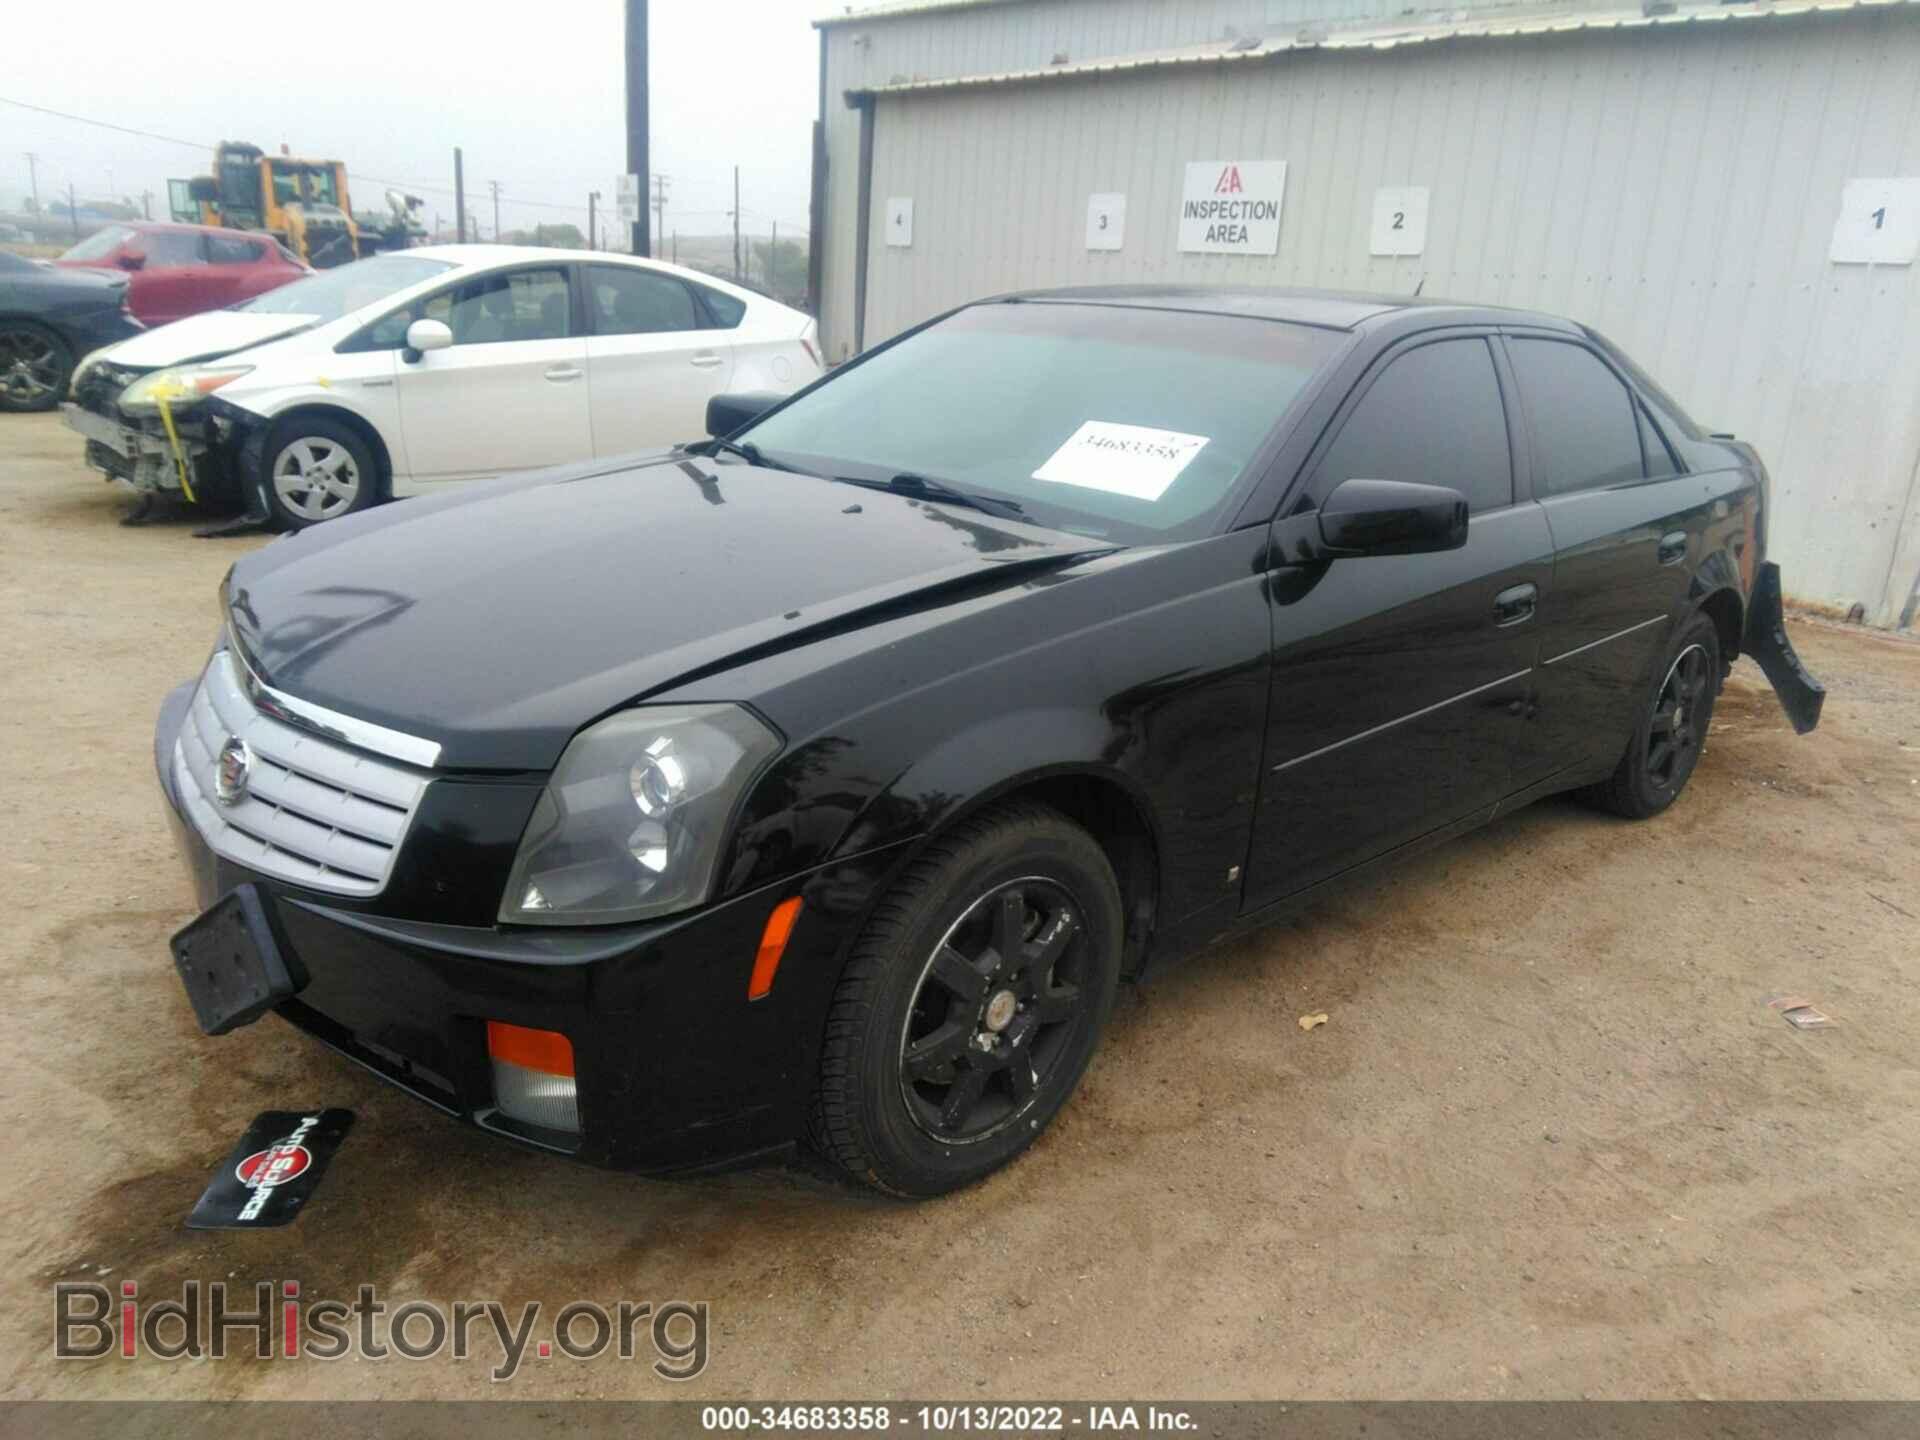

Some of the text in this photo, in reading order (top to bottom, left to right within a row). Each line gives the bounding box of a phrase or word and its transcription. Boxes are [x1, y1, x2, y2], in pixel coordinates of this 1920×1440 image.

[895, 212, 903, 226] 4
[1184, 200, 1278, 220] INSPECTION
[1871, 207, 1886, 229] 1
[1099, 214, 1108, 230] 3
[1392, 211, 1405, 230] 2
[1205, 224, 1248, 243] AREA
[281, 1116, 320, 1154] AUTO
[237, 1156, 295, 1221] SOURCE
